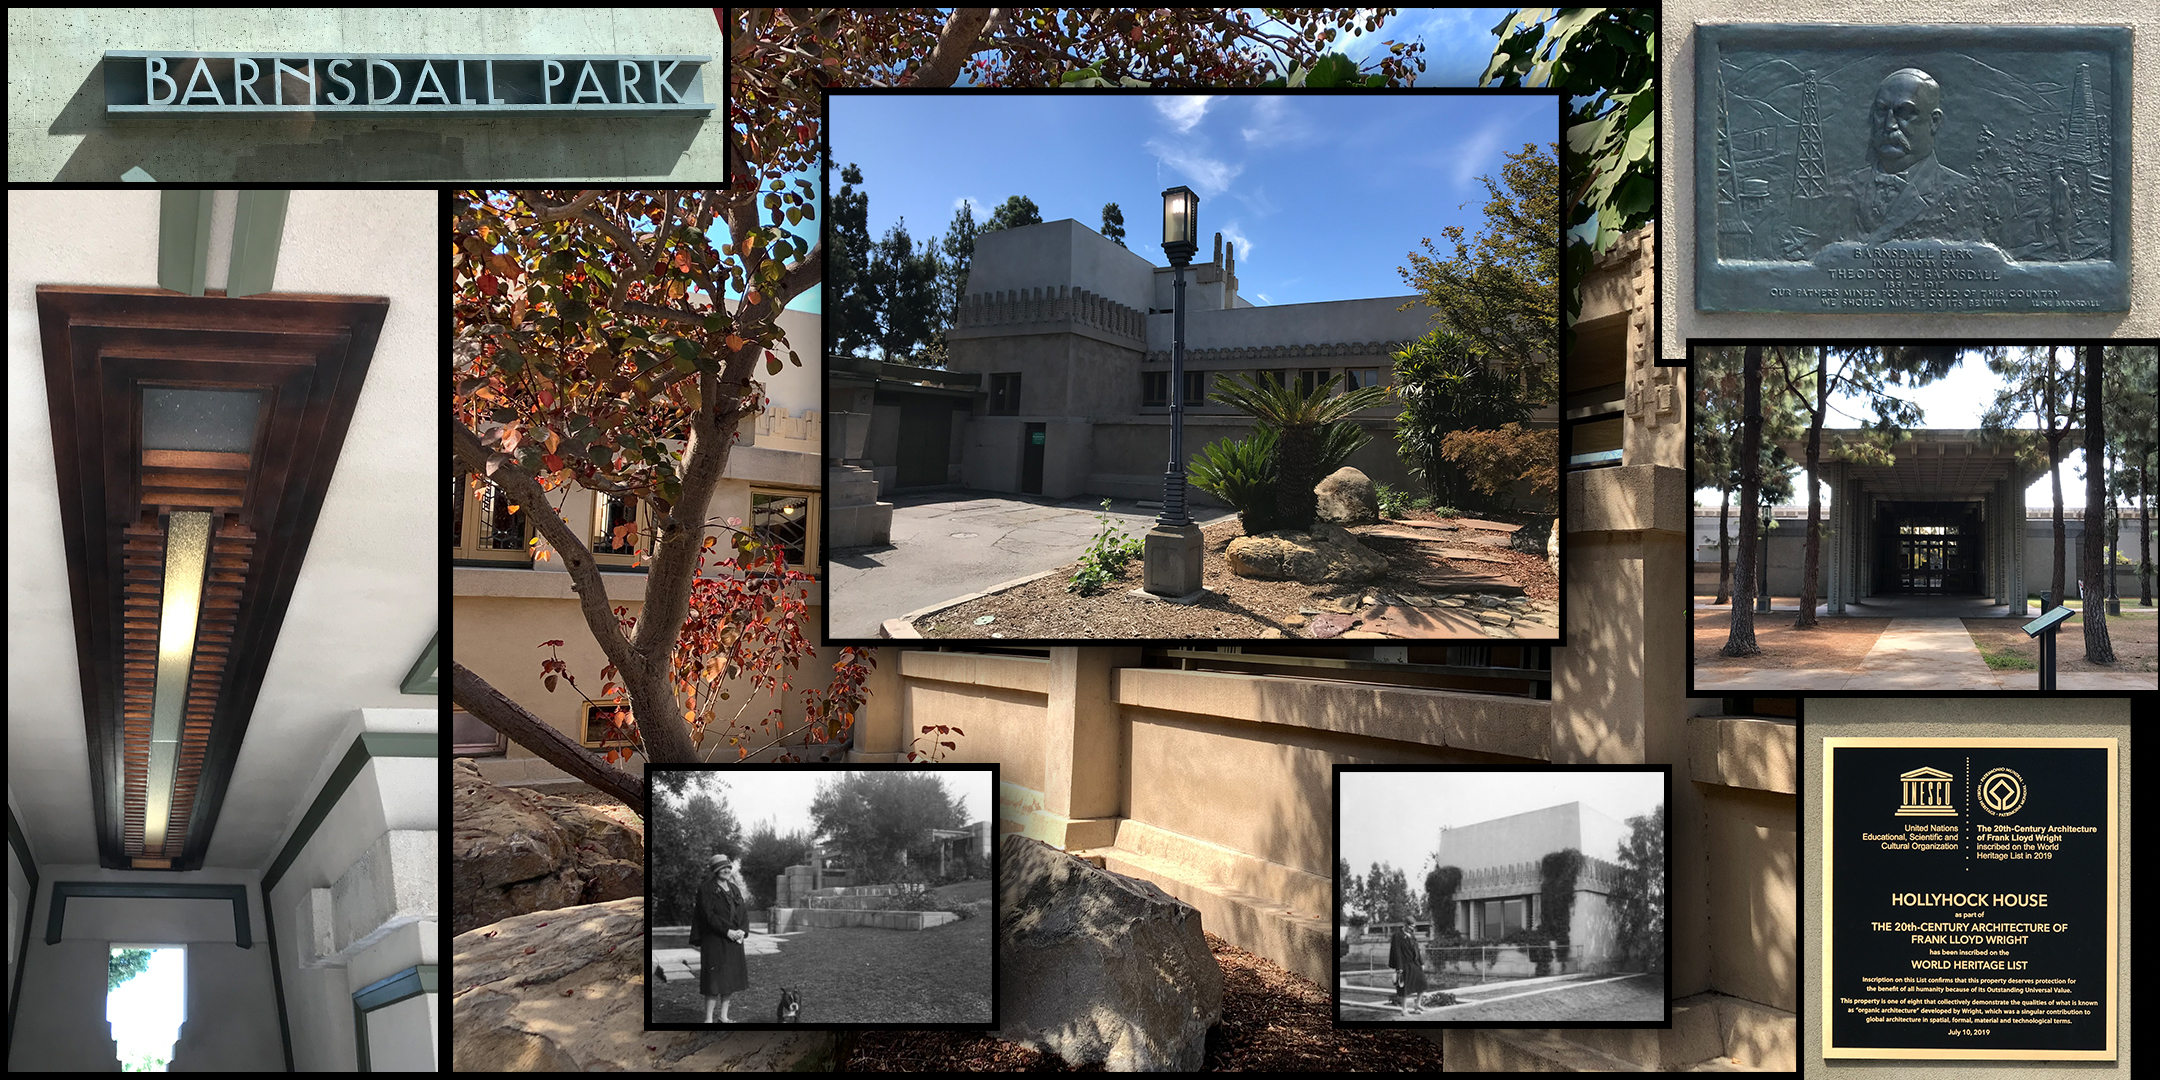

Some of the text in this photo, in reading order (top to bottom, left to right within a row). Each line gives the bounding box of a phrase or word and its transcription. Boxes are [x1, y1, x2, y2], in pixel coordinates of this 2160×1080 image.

[146, 56, 685, 105] BARNSDALL PARK
[1854, 248, 1974, 260] BARNSDALL PARK
[1872, 259, 1956, 268] IN MEMORY OF
[1828, 268, 2000, 281] THEODORE N. BARNSDALL
[1770, 288, 2061, 298] OUR FATHERS MINED FOR THE GOLD OF THIS COUNTRY
[1842, 298, 1884, 306] SHOULD
[1903, 782, 1951, 806] UNESCO
[1904, 824, 1958, 832] United Nations
[1976, 824, 2098, 834] The 20th-Century Architecture
[1862, 832, 1958, 842] Educational, Scientific and
[1976, 832, 2062, 844] of Frank Lloyd Wright
[1880, 842, 1958, 852] Cultural Organization
[1976, 842, 2010, 850] inscribed
[2024, 842, 2036, 850] the
[2036, 842, 2060, 850] World
[1976, 852, 2052, 862] Heritage List in 2019
[1892, 892, 2048, 908] HOLLYHOCK HOUSE
[1870, 922, 2068, 932] THE 20th-CENTURY ARCHITECTURE OF
[1912, 934, 2028, 944] FRANK LLOYD WRIGHT
[1910, 960, 2028, 970] WORLD HERITAGE LIST
[2034, 978, 2066, 986] protection
[1916, 986, 1944, 994] humanity
[1986, 986, 2024, 994] Outstanding
[1936, 998, 1970, 1006] collectively
[1952, 1008, 1960, 1016] by
[1962, 1008, 1984, 1016] Wright,
[2020, 1008, 2046, 1016] singular
[1866, 1016, 1884, 1024] global
[2012, 1018, 2052, 1026] technological
[1948, 1028, 1962, 1036] July
[1962, 1028, 1972, 1036] 10,
